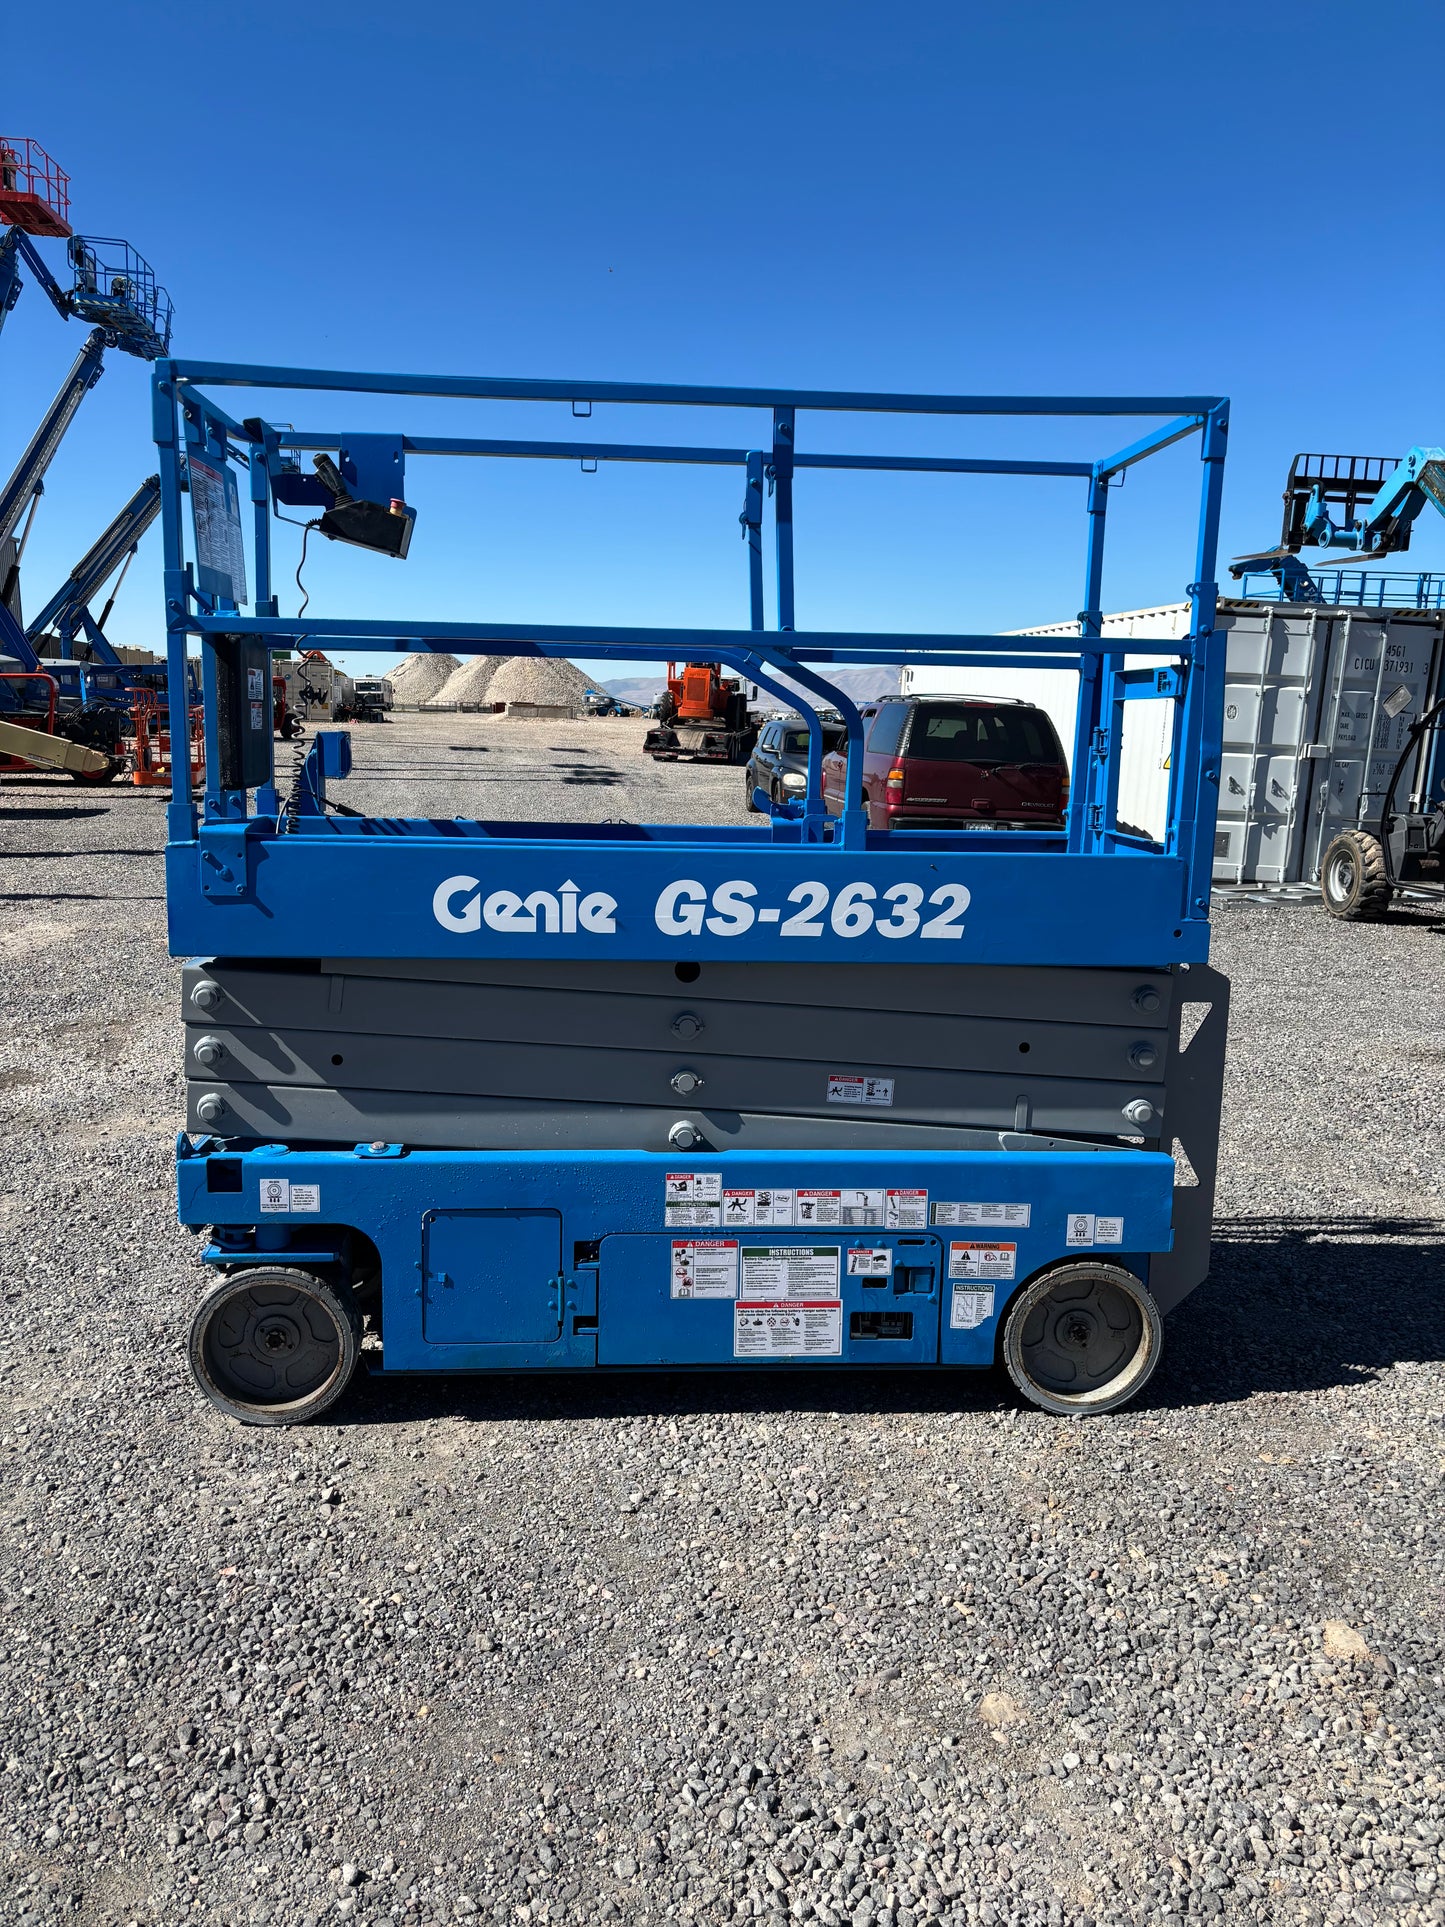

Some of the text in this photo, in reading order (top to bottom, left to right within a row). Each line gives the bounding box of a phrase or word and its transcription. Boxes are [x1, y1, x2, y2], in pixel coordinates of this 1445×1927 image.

[1386, 645, 1406, 657] 45G1
[1354, 658, 1375, 670] CICU
[1384, 660, 1414, 673] 371931
[433, 875, 971, 938] Genie GS-2632
[768, 1248, 814, 1256] INSTRUCTIONS
